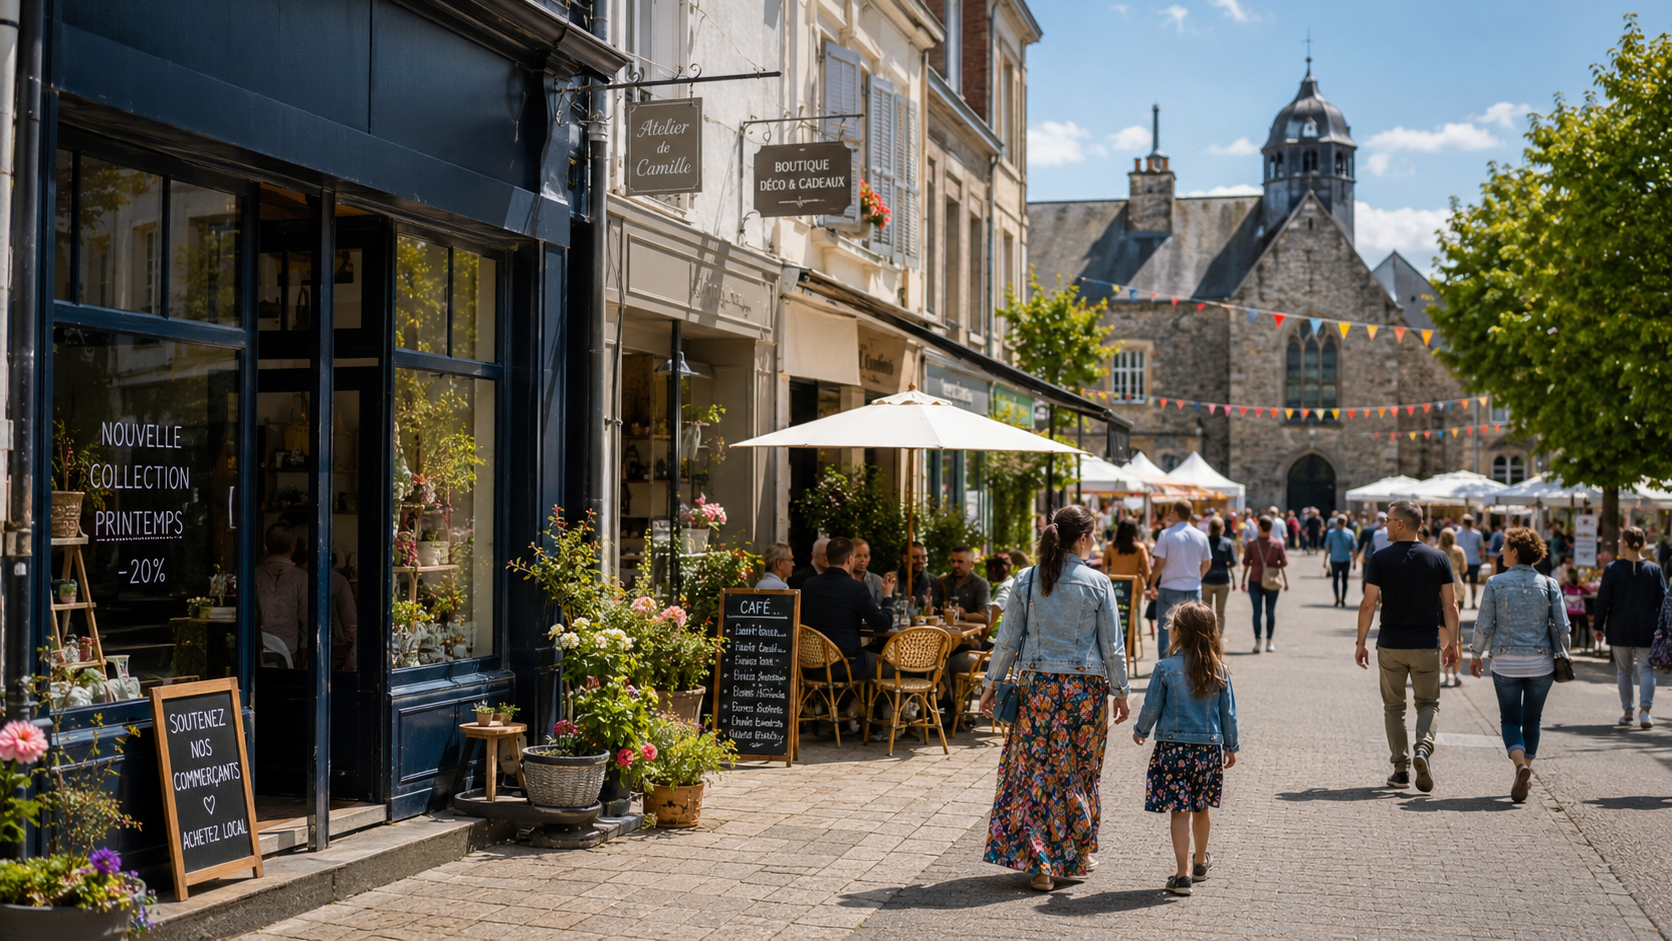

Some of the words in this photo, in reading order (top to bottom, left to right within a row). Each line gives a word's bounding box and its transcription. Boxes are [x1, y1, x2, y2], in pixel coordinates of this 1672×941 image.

[637, 117, 690, 138] Atelier
[656, 140, 671, 154] de
[636, 156, 692, 177] Camille
[775, 159, 830, 173] BOUTIQUE
[760, 177, 786, 191] DÉCO
[788, 179, 796, 190] &
[798, 176, 845, 189] CADEAUX
[101, 421, 182, 449] NOUVELLE
[90, 463, 190, 490] COLLECTION
[95, 510, 184, 537] PRINTEMPS
[118, 557, 166, 584] -20%
[169, 708, 226, 734] SOUTENEZ
[190, 738, 213, 759] NOS
[174, 761, 241, 791] COMMERÇANTS
[183, 825, 220, 850] ACHETEZ
[222, 818, 248, 839] LOCAL
